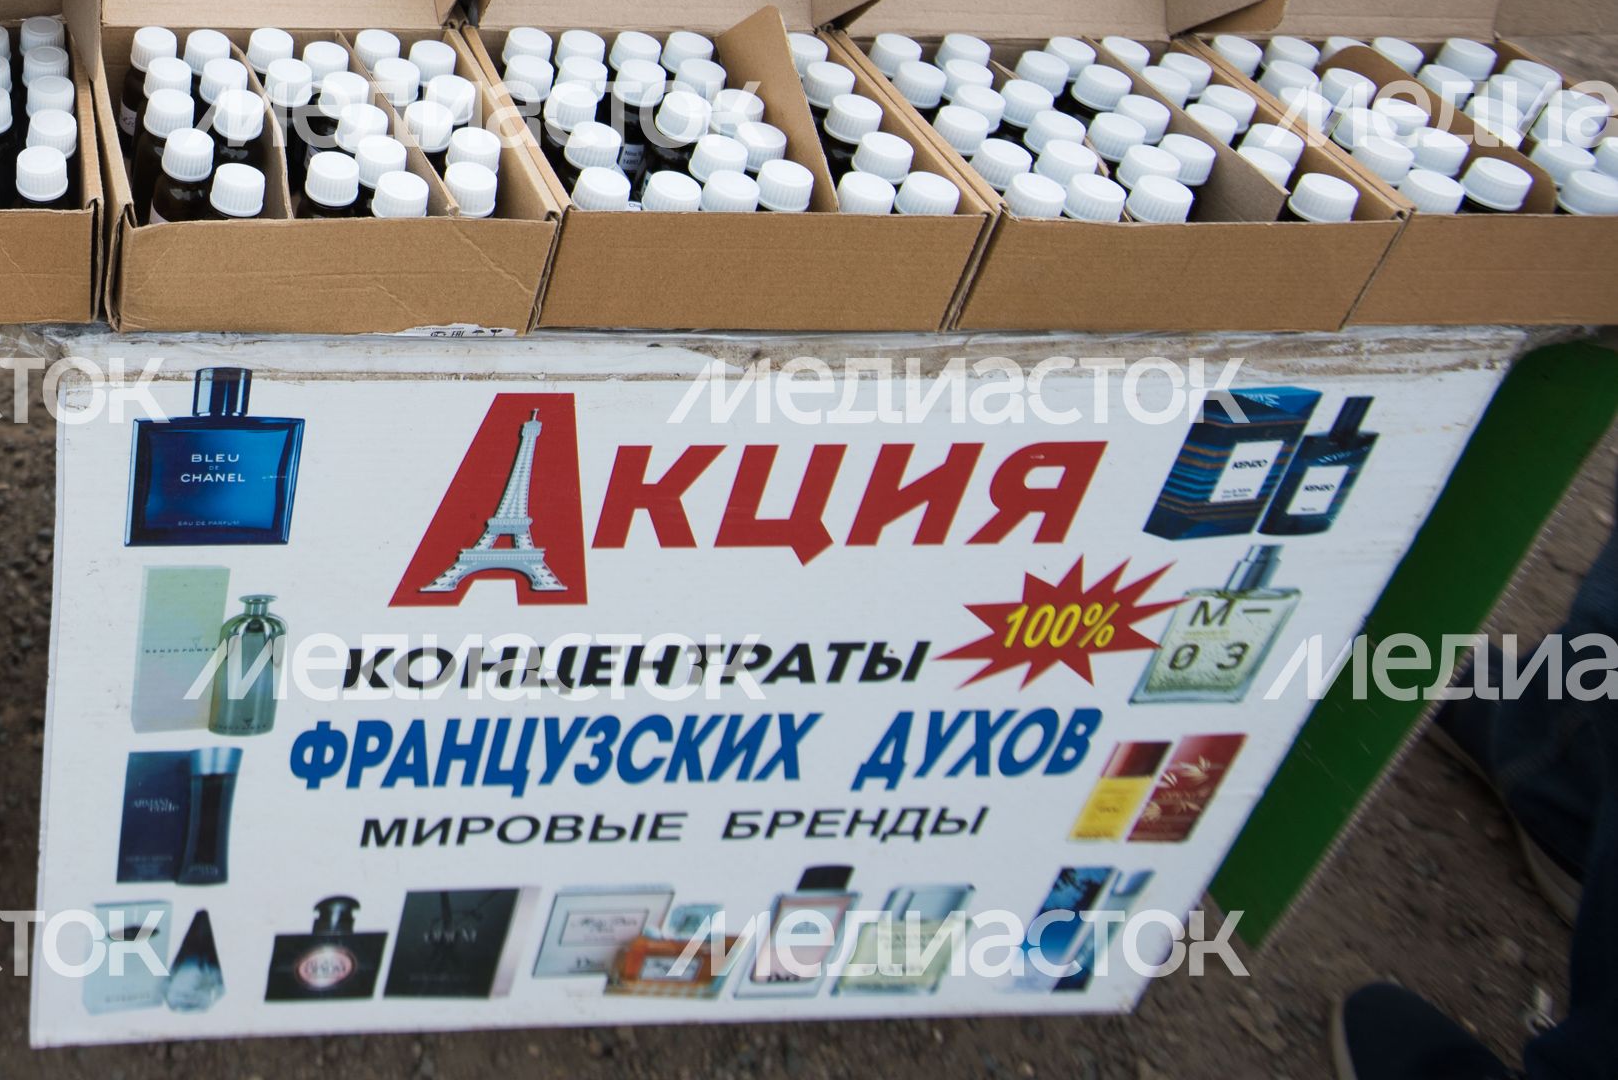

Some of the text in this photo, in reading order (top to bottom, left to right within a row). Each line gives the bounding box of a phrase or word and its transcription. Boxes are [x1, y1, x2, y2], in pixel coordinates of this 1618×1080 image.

[180, 473, 247, 483] CHANEL
[190, 453, 241, 463] BLEU
[1004, 603, 1120, 648] 100%
[342, 641, 931, 695] КОНЦЕНТРАТЫ
[289, 707, 1103, 798] ФРАНЦУЗСКИХ ДУХОВ
[359, 806, 989, 849] МИРОВЫЕ БРЕНДЫ
